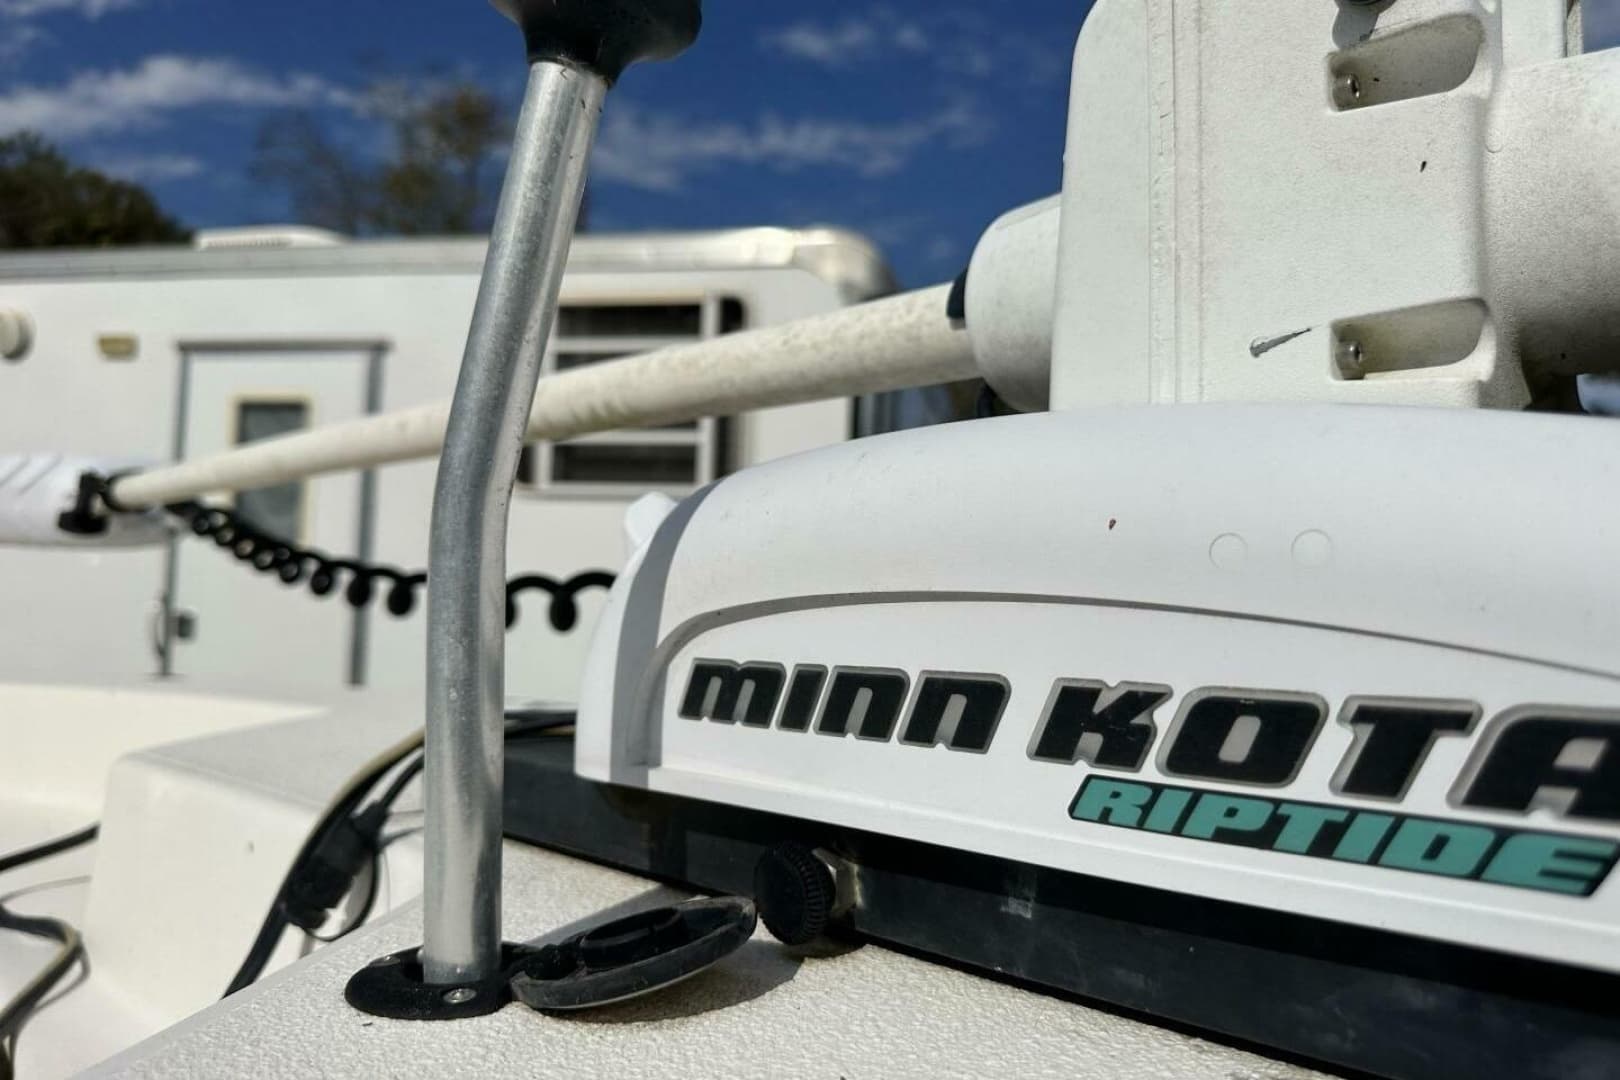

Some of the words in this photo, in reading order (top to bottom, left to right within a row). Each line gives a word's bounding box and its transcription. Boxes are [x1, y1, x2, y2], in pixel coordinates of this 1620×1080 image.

[678, 657, 1011, 754] MINN
[1026, 677, 1620, 823] KOTA
[1070, 775, 1620, 897] RIPTIDE
